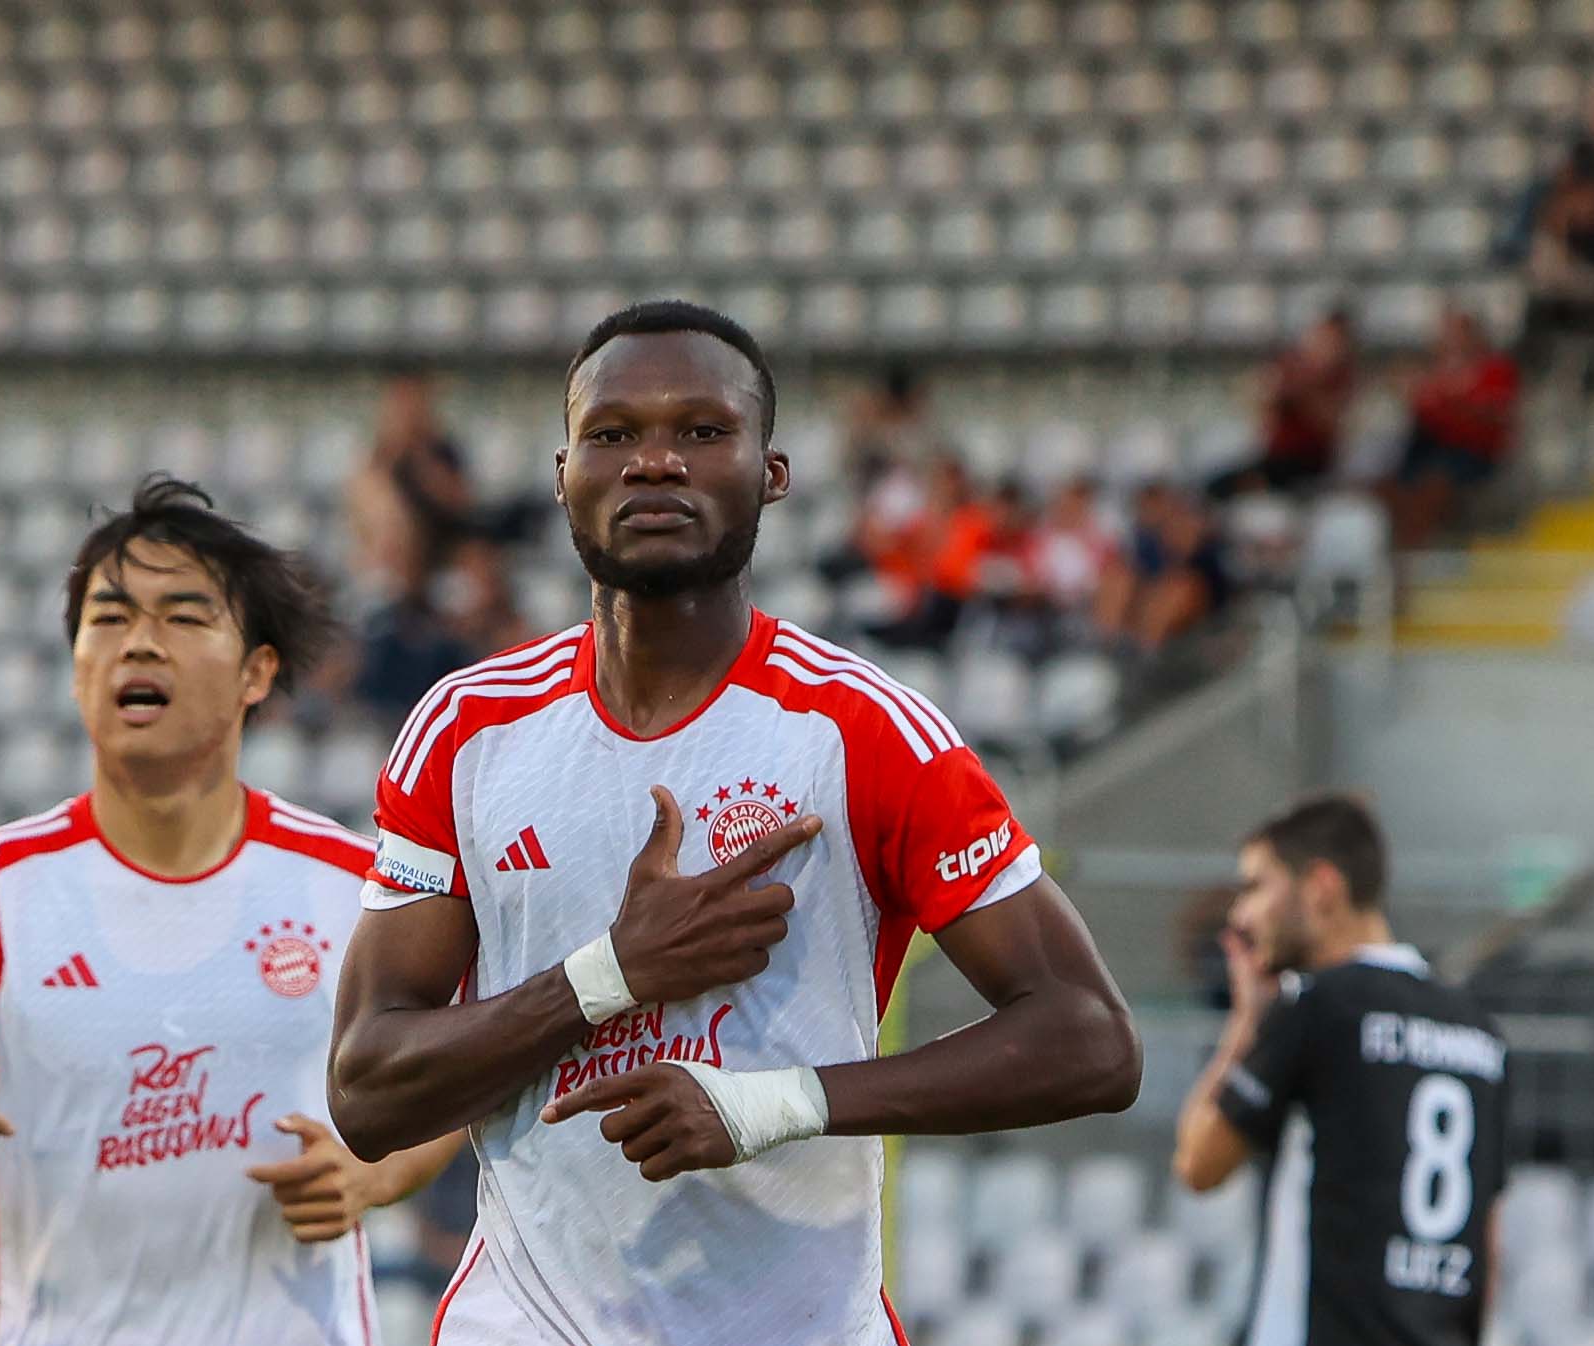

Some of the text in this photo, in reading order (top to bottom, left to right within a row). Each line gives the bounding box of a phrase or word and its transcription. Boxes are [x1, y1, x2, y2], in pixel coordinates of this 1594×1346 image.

[715, 805, 778, 834] FC BAYERN
[122, 1069, 209, 1128] GEGEN
[129, 1042, 218, 1096] ROT
[96, 1092, 266, 1172] RASSISMUS
[1400, 1072, 1475, 1242] 8
